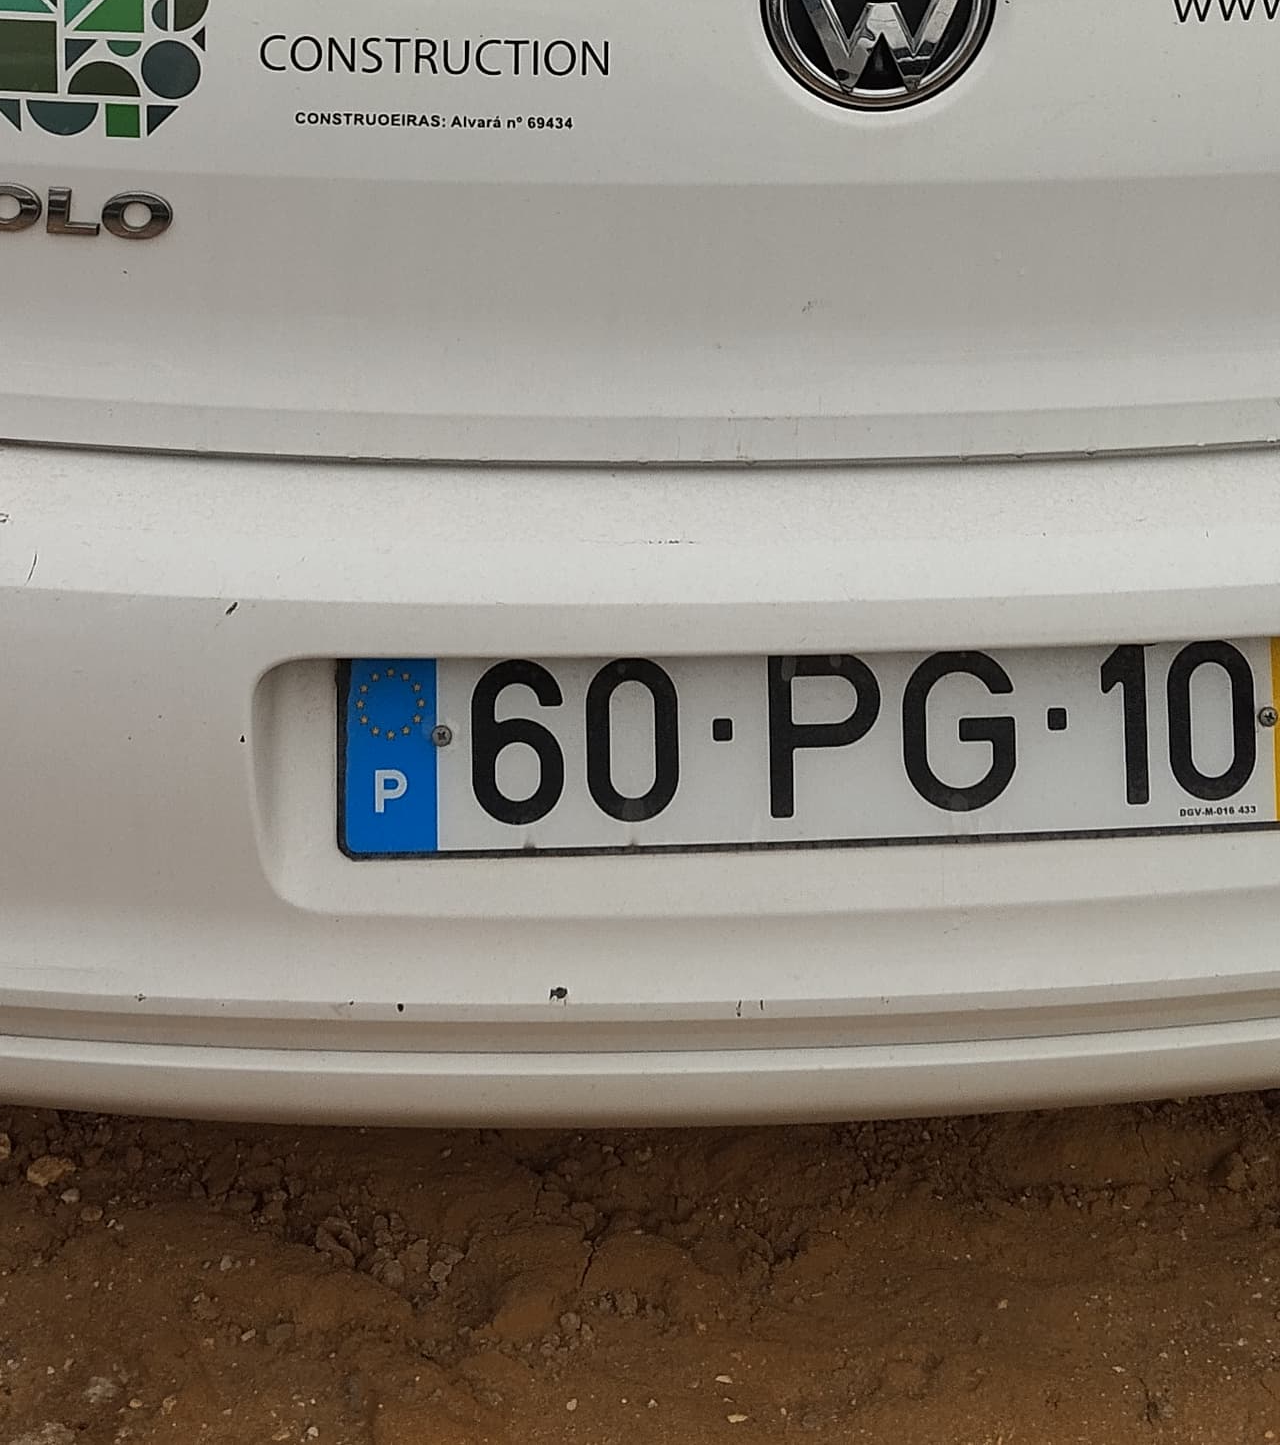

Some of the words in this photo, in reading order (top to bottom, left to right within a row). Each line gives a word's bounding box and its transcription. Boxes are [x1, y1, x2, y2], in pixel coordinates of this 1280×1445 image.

[259, 34, 610, 76] CONSTRUCTION
[295, 112, 446, 128] CONSTRUOEIRAS:
[451, 115, 501, 129] Alvará
[527, 116, 574, 129] 69434
[374, 770, 408, 813] P
